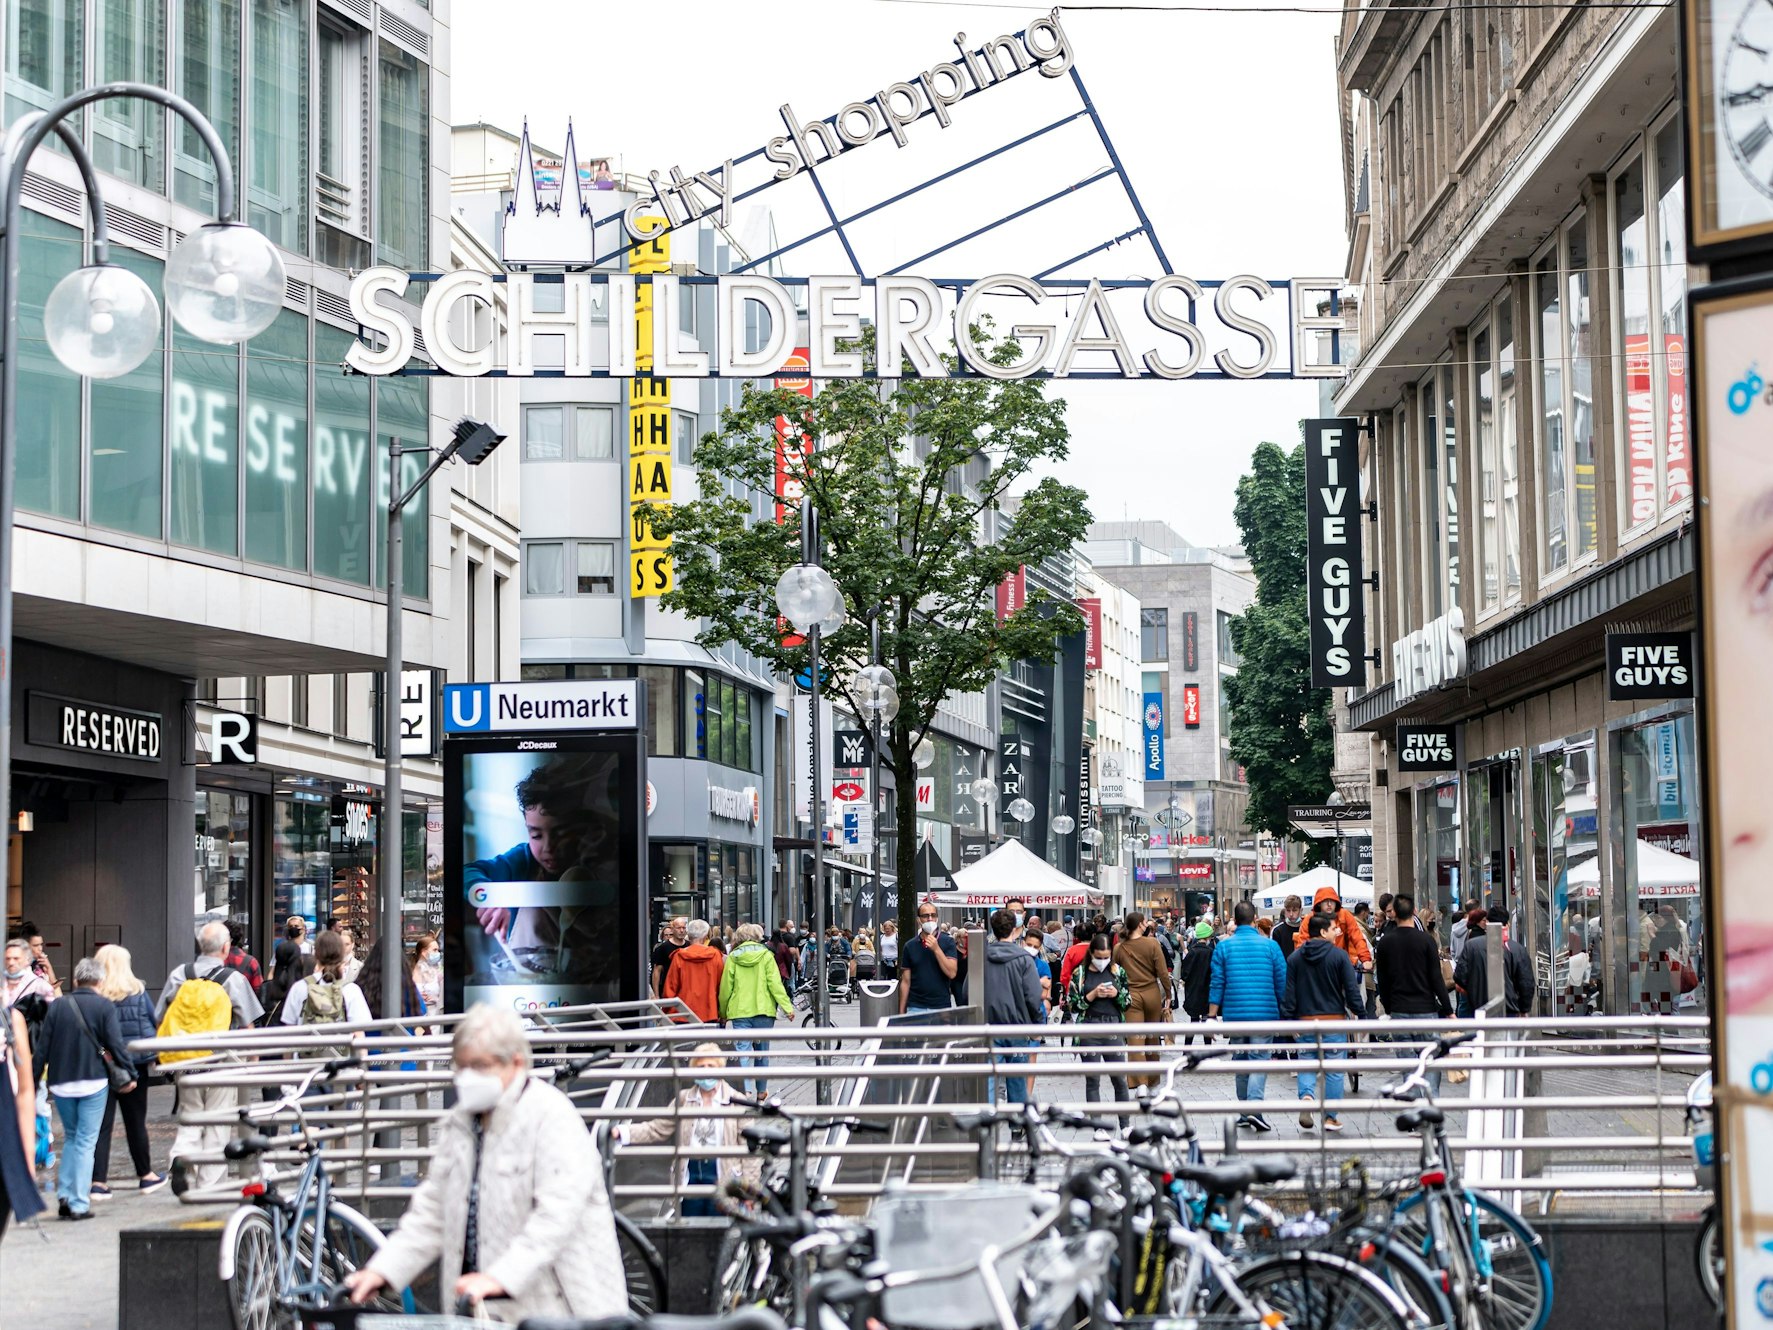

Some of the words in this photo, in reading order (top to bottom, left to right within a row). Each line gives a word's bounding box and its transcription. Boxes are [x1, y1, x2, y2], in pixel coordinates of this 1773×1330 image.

[623, 158, 734, 243] city
[764, 13, 1075, 180] shopping
[344, 265, 1347, 379] SCHILDERGASSE
[171, 378, 420, 515] RESERVED
[1320, 428, 1348, 545] FIVE
[1321, 557, 1352, 677] GUYS
[1621, 645, 1680, 666] FIVE
[1615, 665, 1688, 686] GUYS
[451, 689, 482, 727] U
[498, 691, 629, 720] Neumarkt
[63, 706, 160, 758] RESERVED
[211, 713, 256, 763] R
[517, 741, 558, 750] JCDecaux
[842, 735, 865, 764] WMF
[1406, 733, 1448, 748] FIVE
[1149, 734, 1162, 771] Apollo
[1402, 748, 1453, 763] GUYS
[1294, 809, 1333, 817] TRAURING
[966, 893, 999, 905] ÄRZTE
[1036, 895, 1085, 905] GRENZEN
